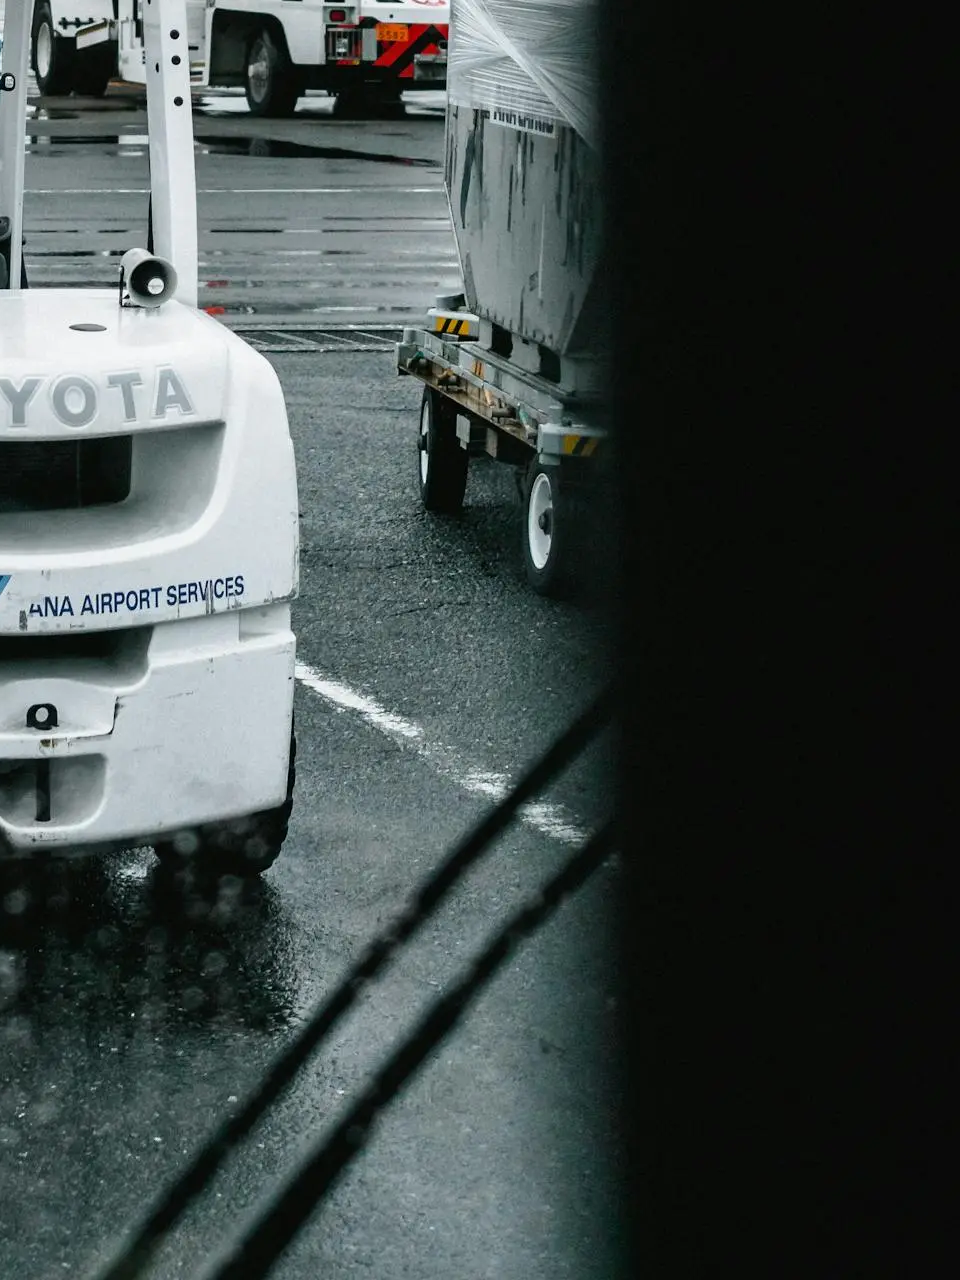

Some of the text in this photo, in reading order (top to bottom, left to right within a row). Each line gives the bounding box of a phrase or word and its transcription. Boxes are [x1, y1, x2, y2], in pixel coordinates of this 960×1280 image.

[28, 575, 245, 618] ANA AIRPORT SERVICES
